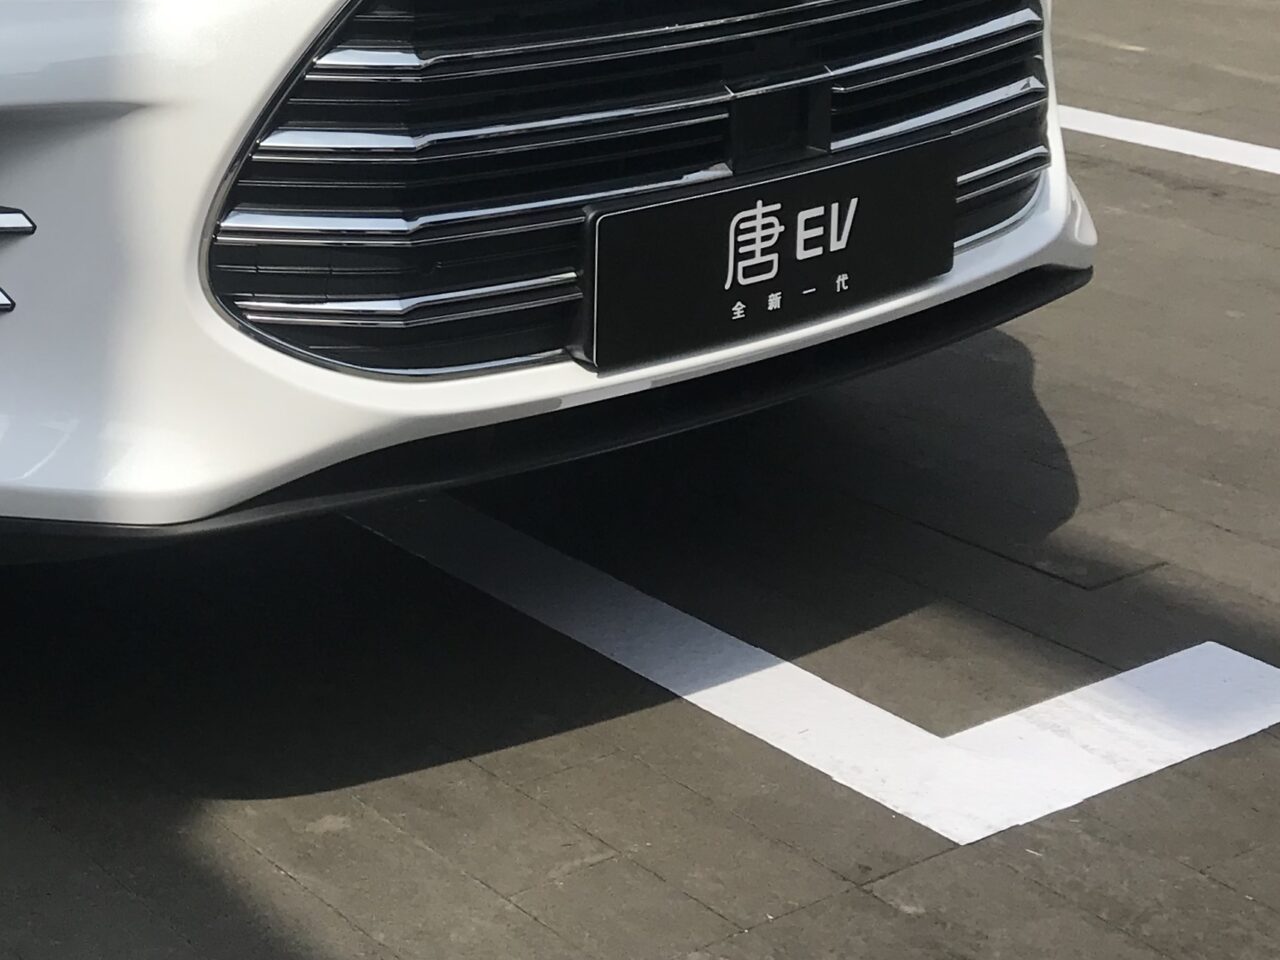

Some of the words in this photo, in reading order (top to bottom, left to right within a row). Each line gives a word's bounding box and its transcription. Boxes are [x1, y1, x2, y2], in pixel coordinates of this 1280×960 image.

[796, 197, 859, 261] EV
[731, 273, 849, 320] 全新一代
